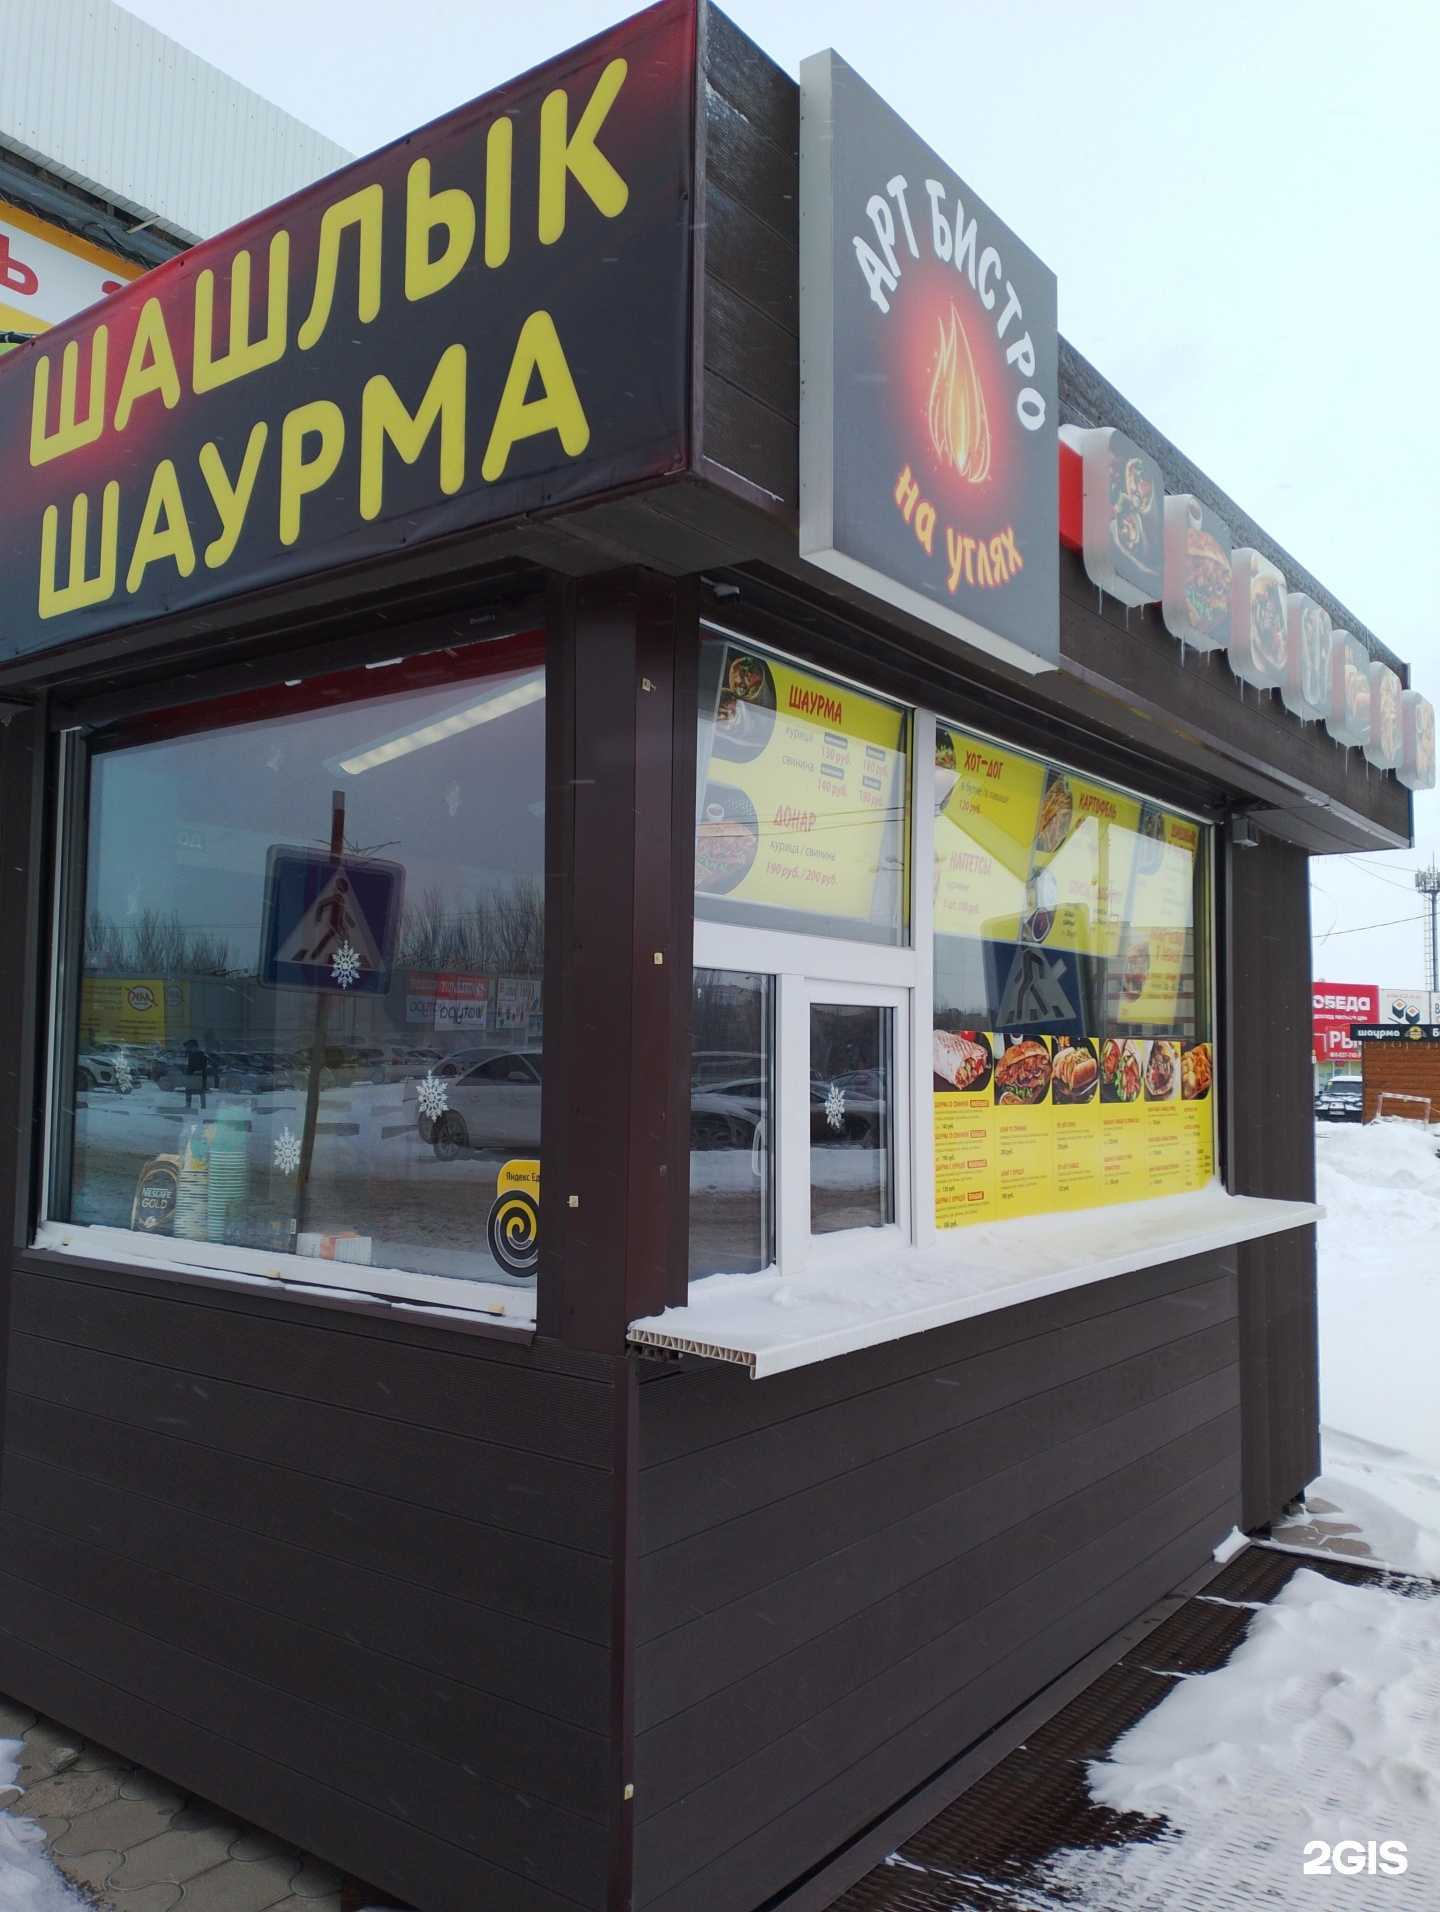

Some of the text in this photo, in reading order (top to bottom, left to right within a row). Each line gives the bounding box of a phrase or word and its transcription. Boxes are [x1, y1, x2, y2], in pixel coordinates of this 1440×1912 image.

[30, 58, 629, 467] ШАШЛЫК
[853, 174, 1047, 432] АРТ БИСТРО
[38, 310, 590, 620] ШАУРМА
[895, 464, 1024, 595] на углях
[789, 684, 842, 725] ШАУРМА
[964, 750, 1004, 780] ХОТ-ДОГ
[774, 804, 816, 832] ДОНАР
[141, 1198, 168, 1210] GOLD
